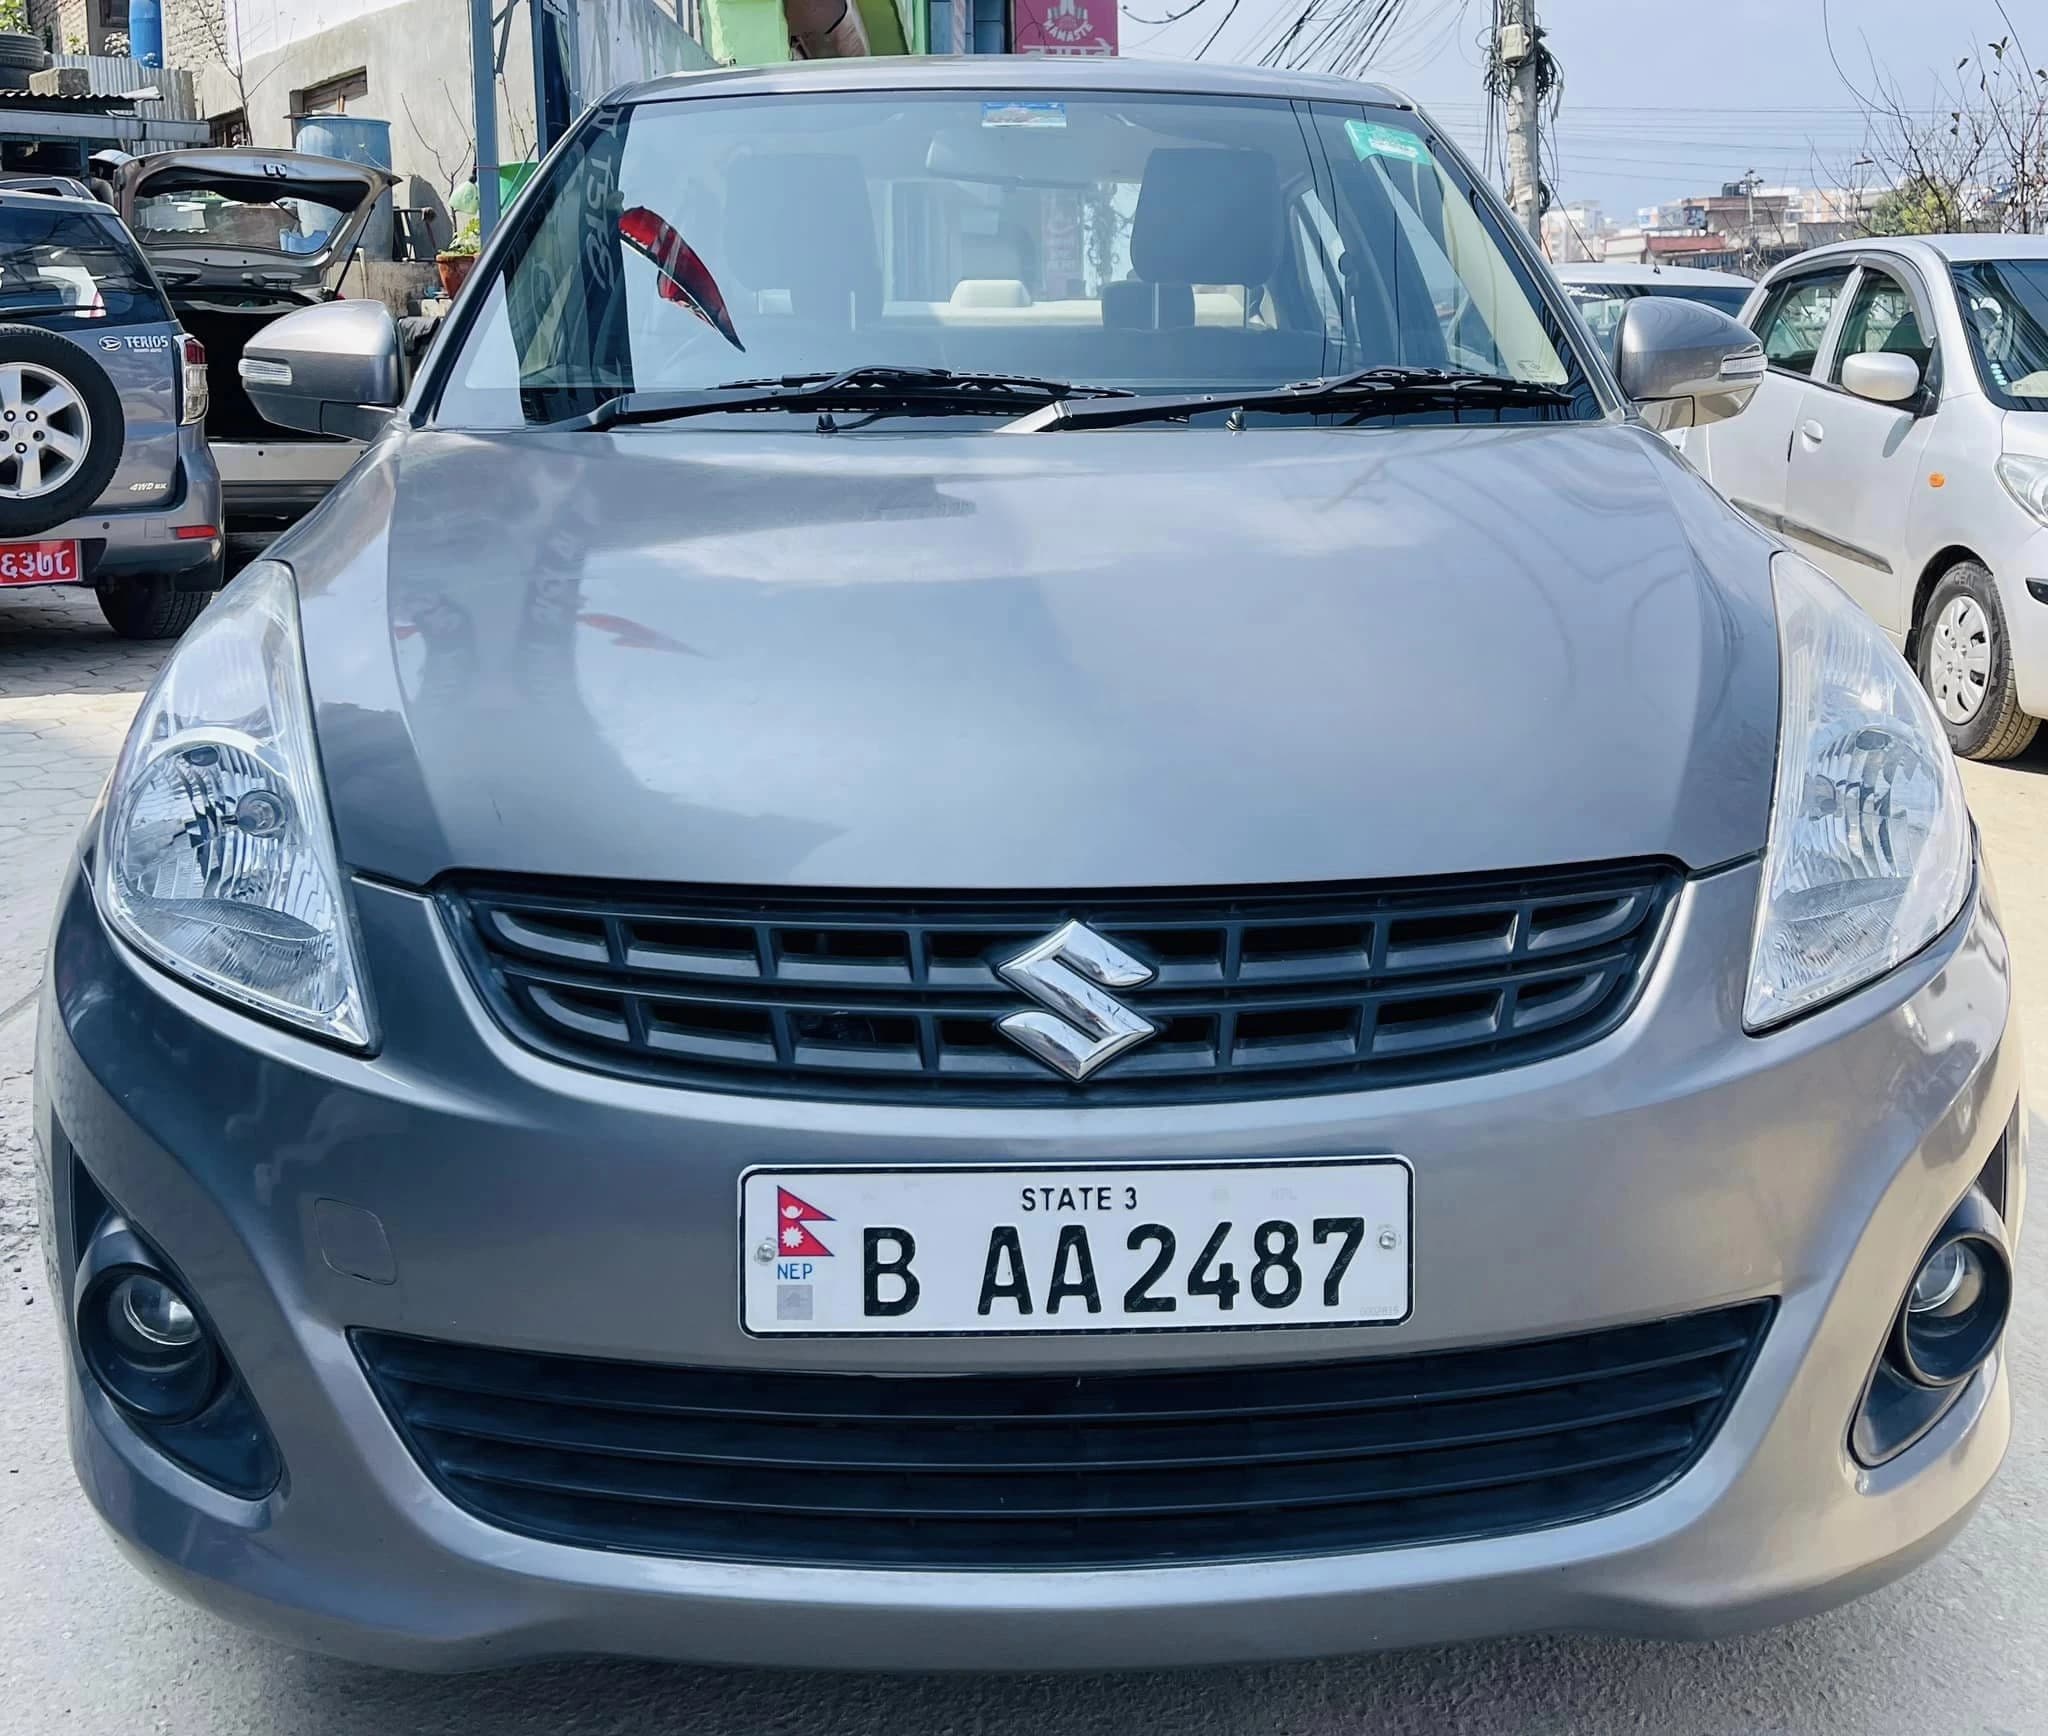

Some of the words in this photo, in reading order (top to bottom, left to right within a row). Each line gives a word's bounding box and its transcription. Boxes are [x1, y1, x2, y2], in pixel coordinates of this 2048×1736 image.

[1043, 20, 1094, 42] NAMASTE
[124, 335, 169, 348] TERIOS
[1022, 1186, 1112, 1212] STATE
[1124, 1186, 1138, 1210] 3
[776, 1262, 814, 1280] NEP
[863, 1226, 921, 1317] B
